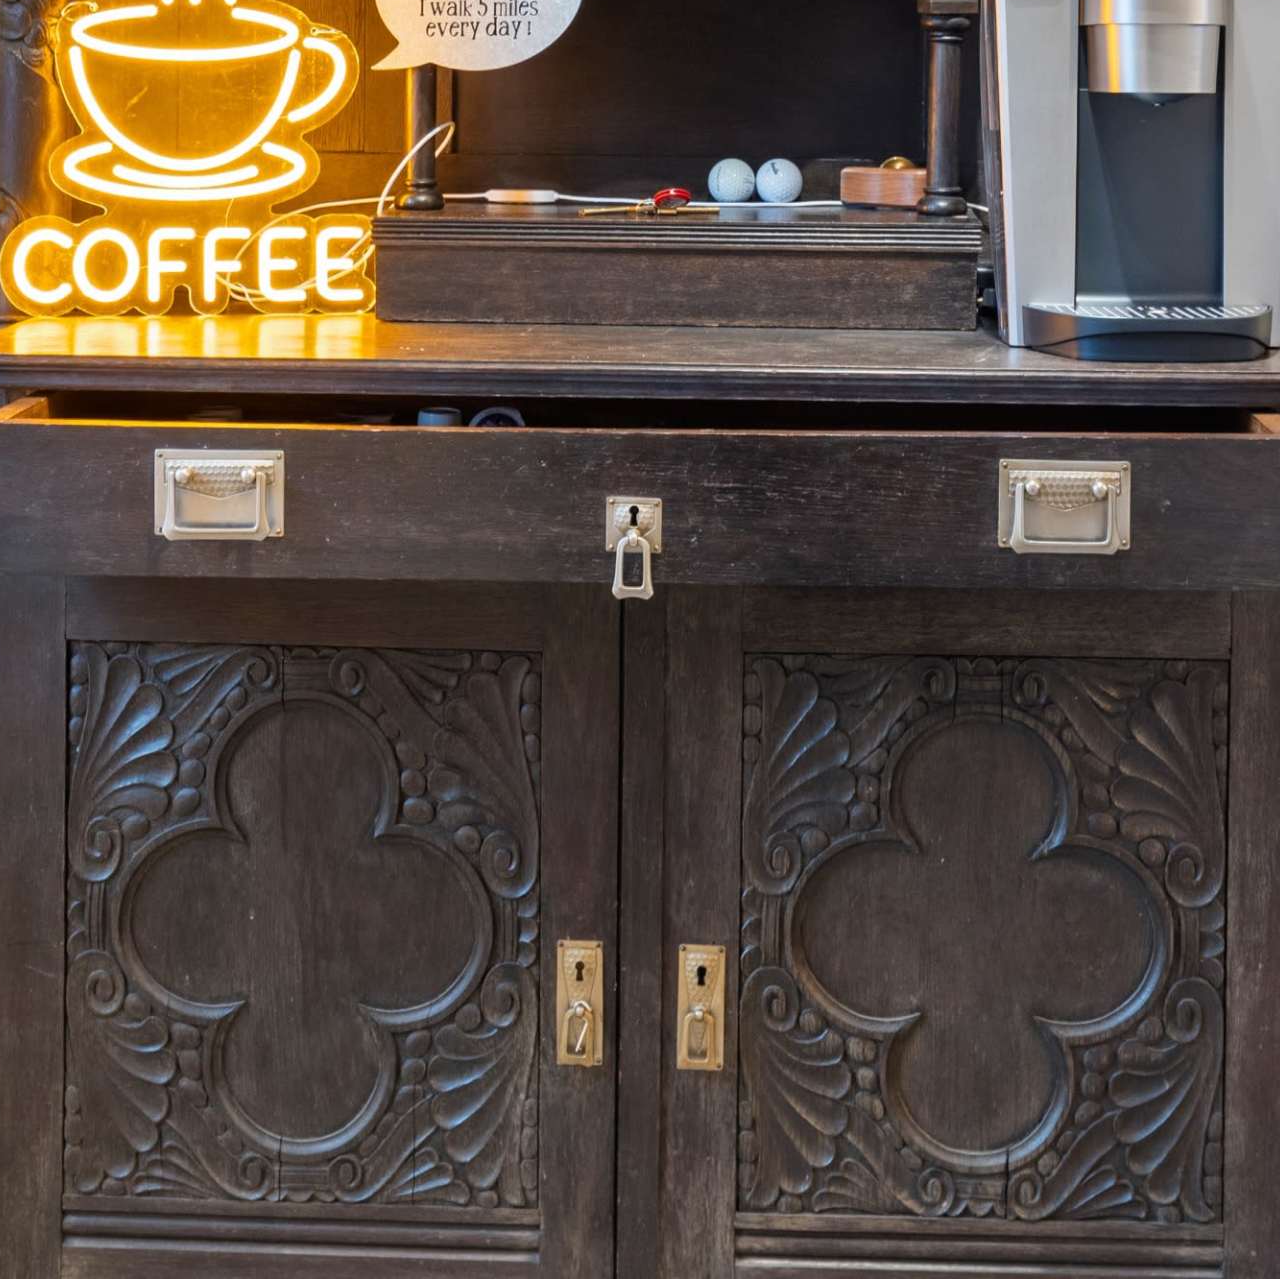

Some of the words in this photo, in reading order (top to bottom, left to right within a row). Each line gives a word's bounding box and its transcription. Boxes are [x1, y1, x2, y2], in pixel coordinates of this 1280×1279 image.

[419, 0, 424, 17] I
[430, 0, 472, 17] walk
[426, 22, 480, 40] every
[485, 17, 521, 40] day
[13, 226, 365, 304] COFFEE
